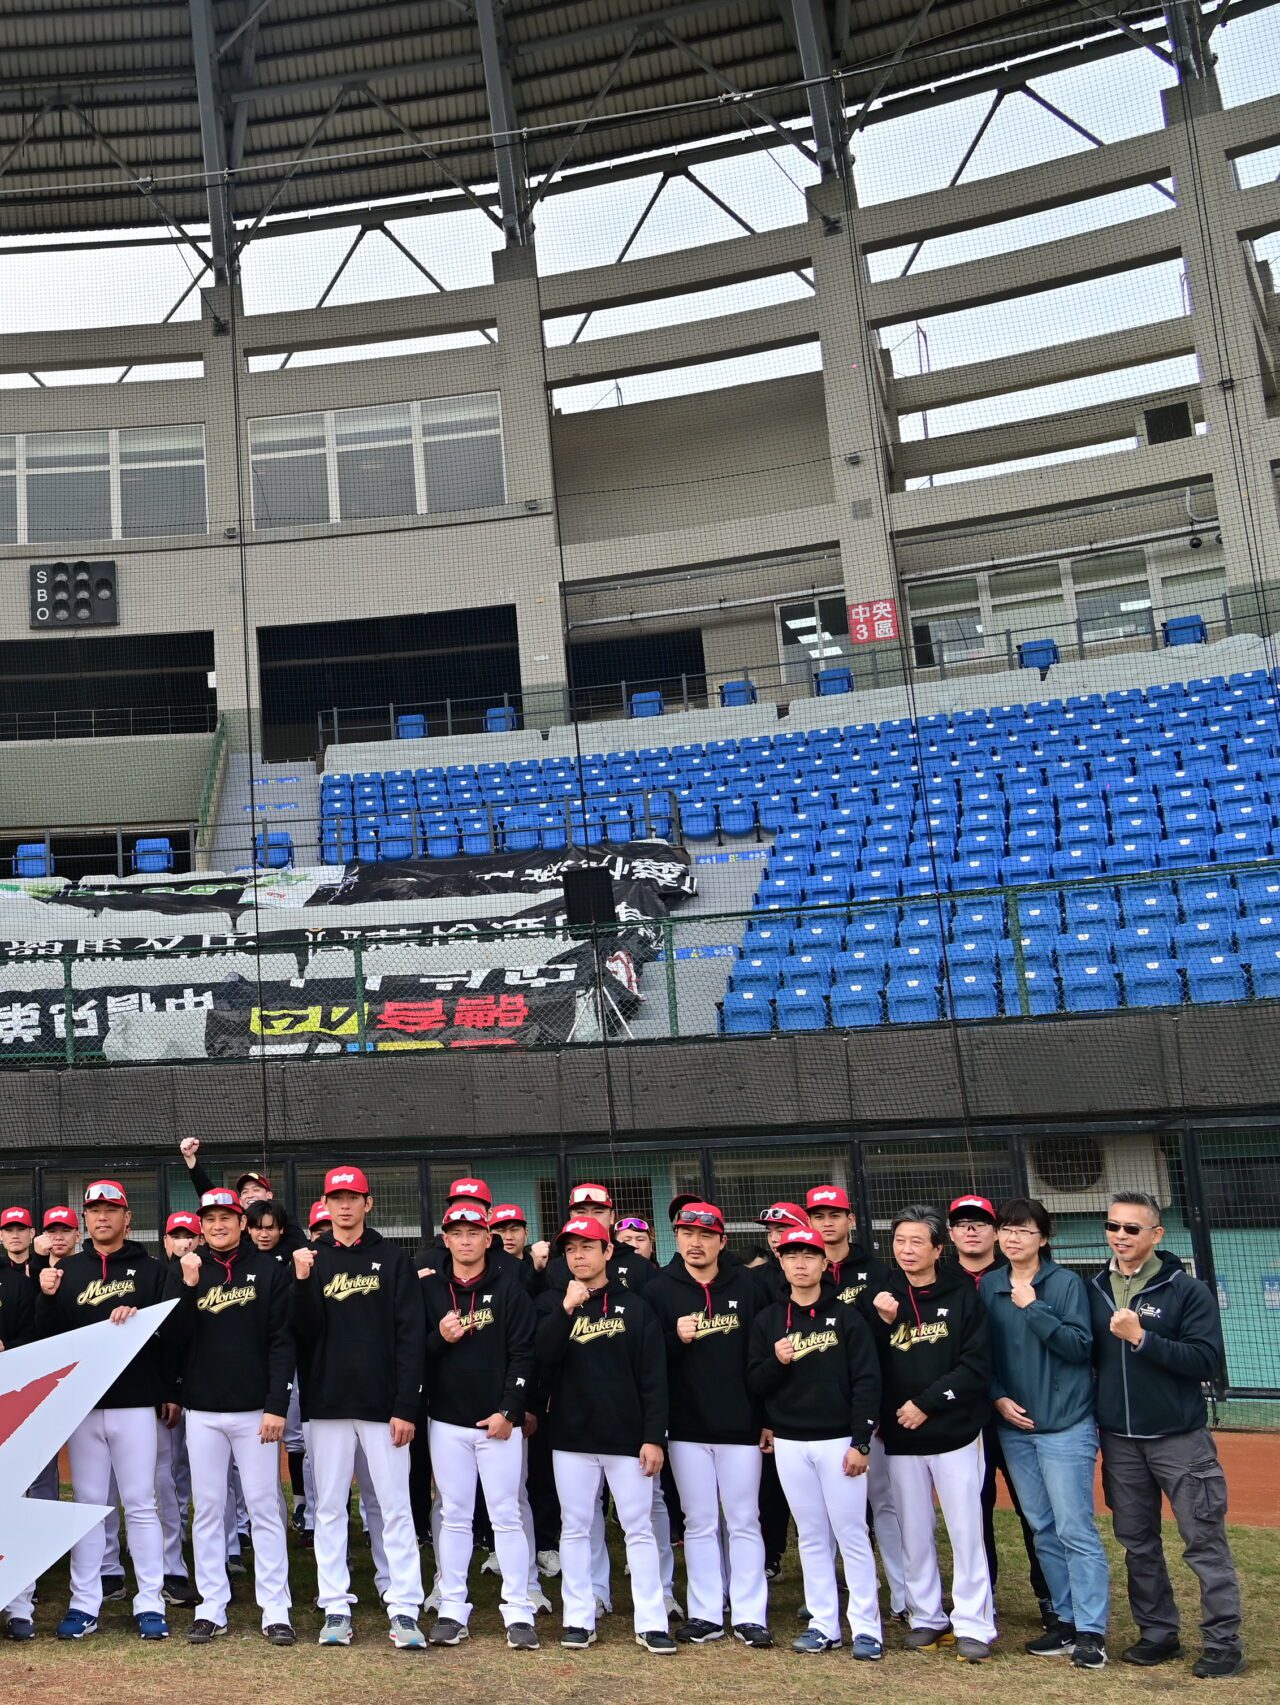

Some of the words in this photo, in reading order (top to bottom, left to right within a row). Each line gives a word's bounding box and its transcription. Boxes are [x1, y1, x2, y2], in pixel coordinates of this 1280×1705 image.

[36, 570, 48, 584] S
[37, 589, 48, 602] B
[36, 607, 50, 621] O
[851, 601, 893, 623] 中央
[856, 619, 895, 640] 3區
[77, 1279, 136, 1306] Monkeys
[323, 1271, 380, 1301] Monkeys
[197, 1284, 257, 1314] Monkeys
[569, 1315, 626, 1344] Monkeys
